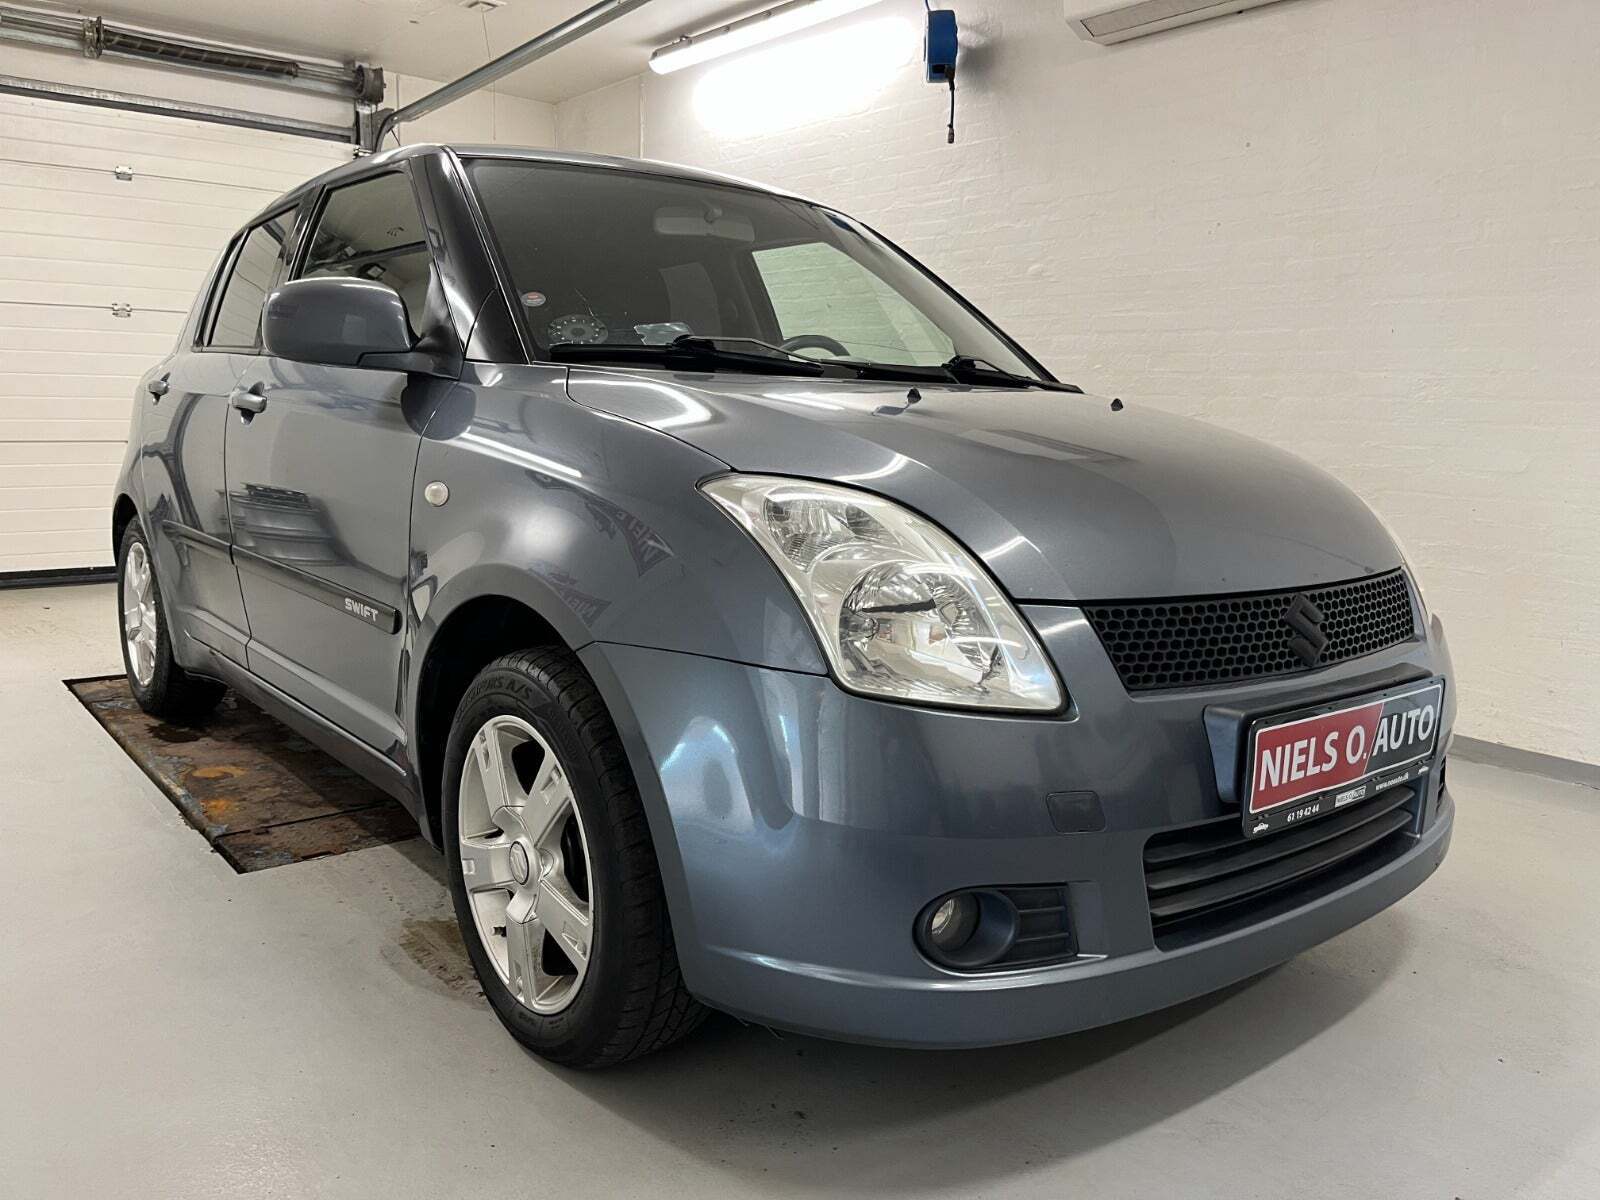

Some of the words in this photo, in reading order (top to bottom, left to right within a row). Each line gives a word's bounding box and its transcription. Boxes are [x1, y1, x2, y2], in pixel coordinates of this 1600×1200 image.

[344, 597, 379, 622] SWIFT
[1258, 730, 1340, 791] NIELS
[1345, 724, 1367, 765] O.
[1372, 704, 1435, 757] AUTO
